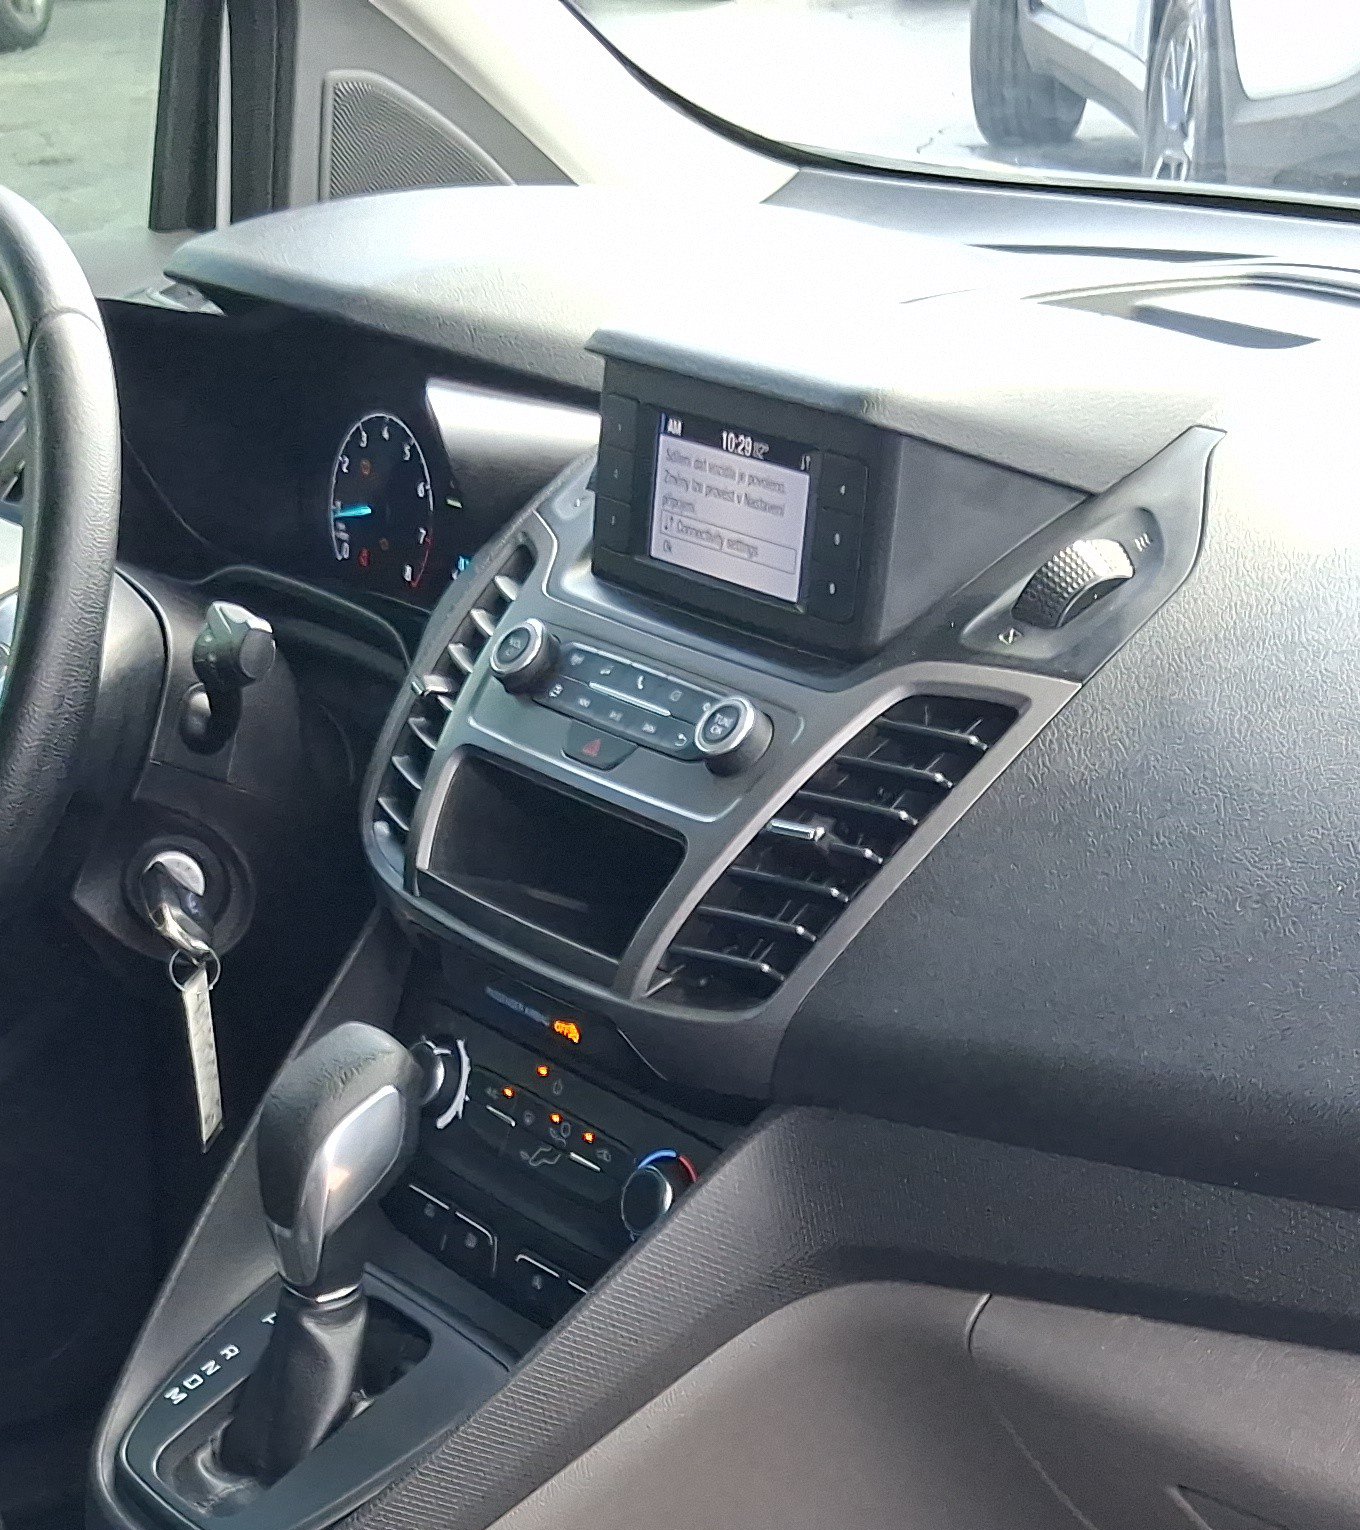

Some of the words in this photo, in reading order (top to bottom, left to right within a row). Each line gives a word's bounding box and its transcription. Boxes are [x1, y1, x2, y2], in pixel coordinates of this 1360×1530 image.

[722, 430, 752, 457] 10:29
[220, 1344, 240, 1361] R
[200, 1359, 221, 1376] N
[182, 1373, 204, 1390] D
[164, 1387, 188, 1405] M
